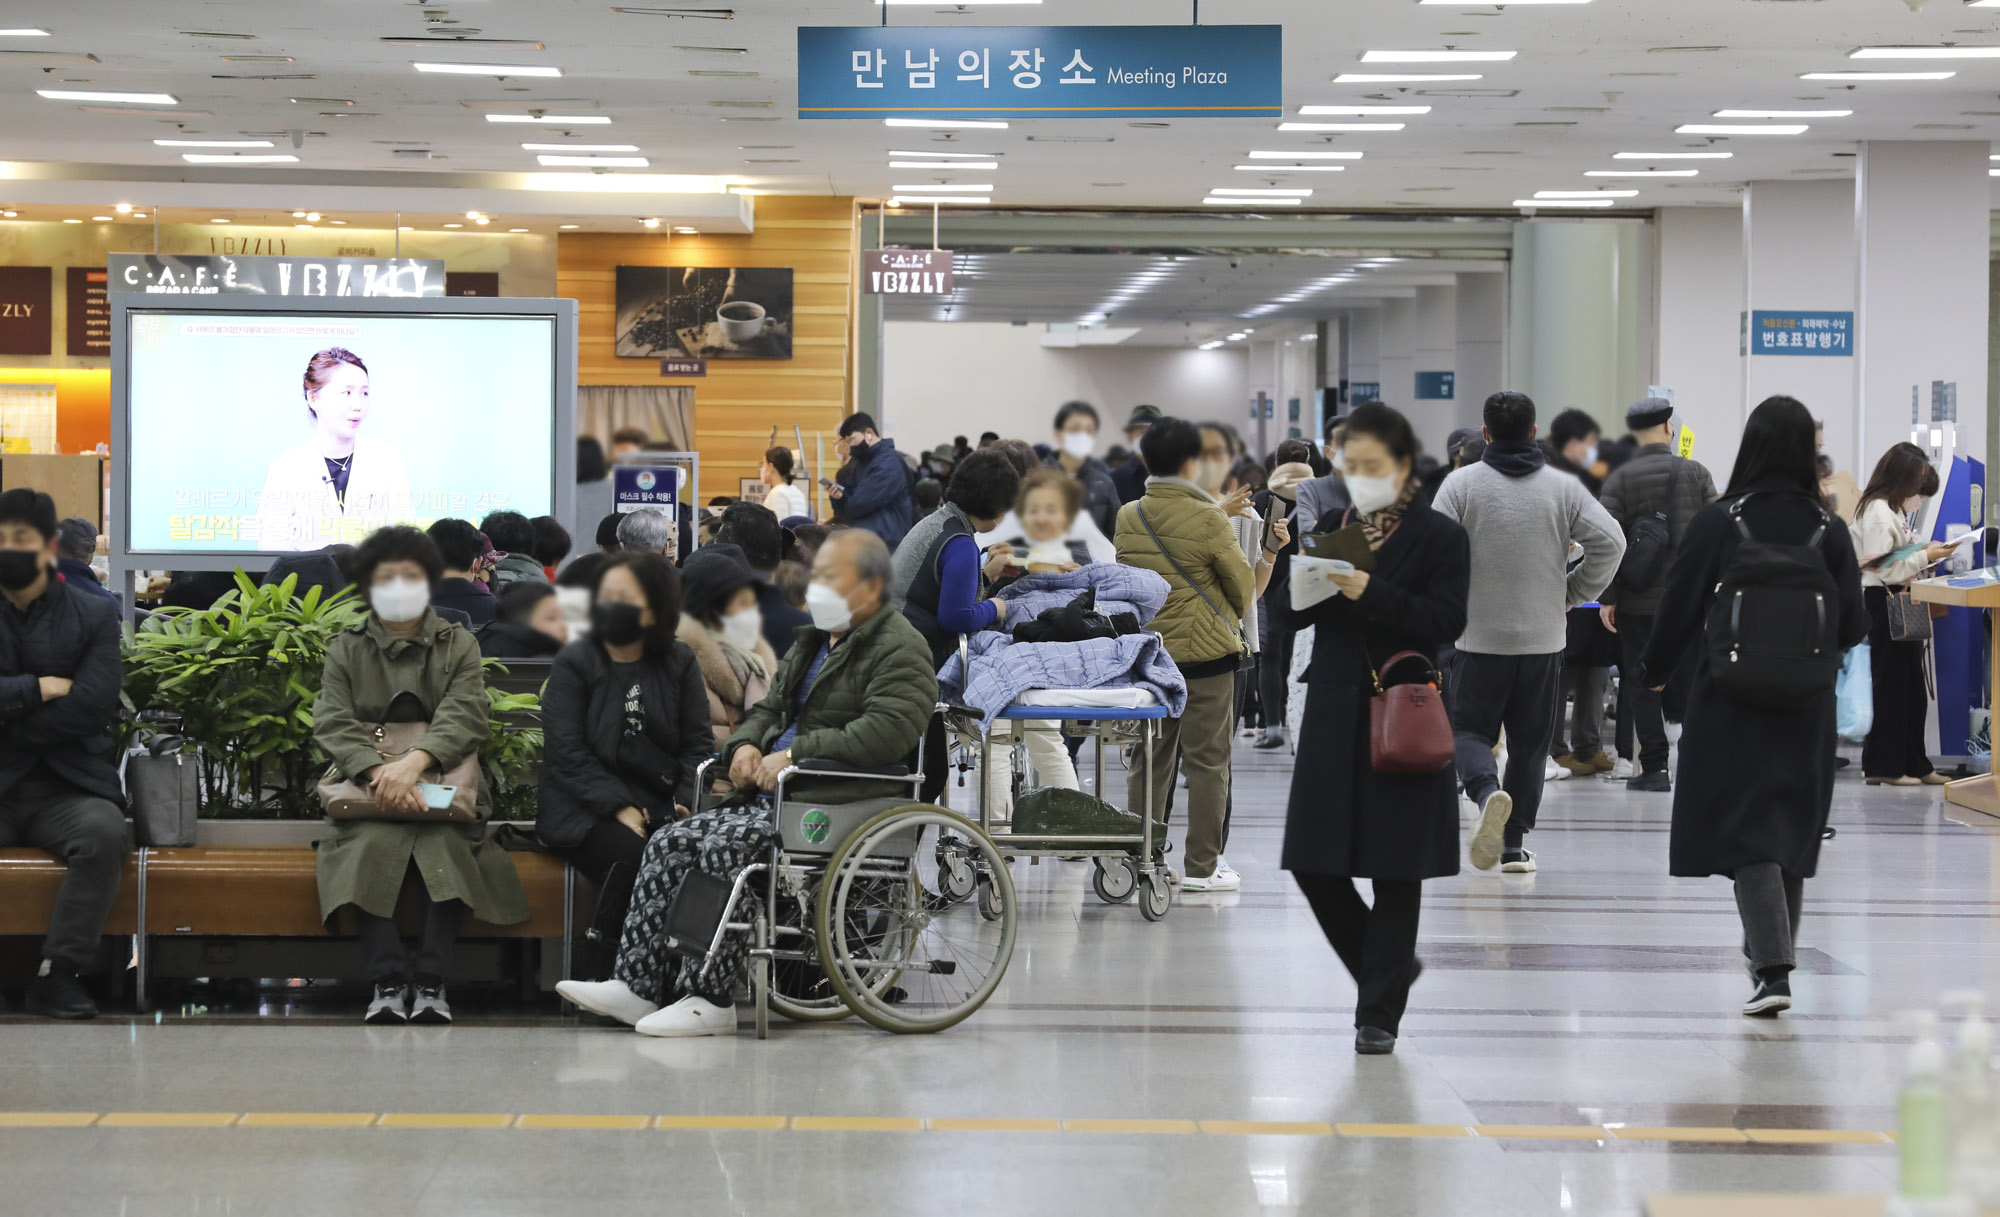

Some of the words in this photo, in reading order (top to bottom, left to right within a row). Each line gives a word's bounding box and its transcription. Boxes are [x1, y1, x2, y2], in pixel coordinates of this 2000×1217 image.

[1107, 66, 1176, 89] Meeting
[1183, 66, 1228, 85] Plaza
[2, 303, 34, 318] ZLY
[1762, 331, 1846, 349] 번호표발행기
[174, 487, 247, 509] 알레르기
[471, 490, 509, 512] 경우
[619, 492, 640, 501] 마스크
[641, 492, 655, 502] 필수
[656, 492, 672, 502] 착용!
